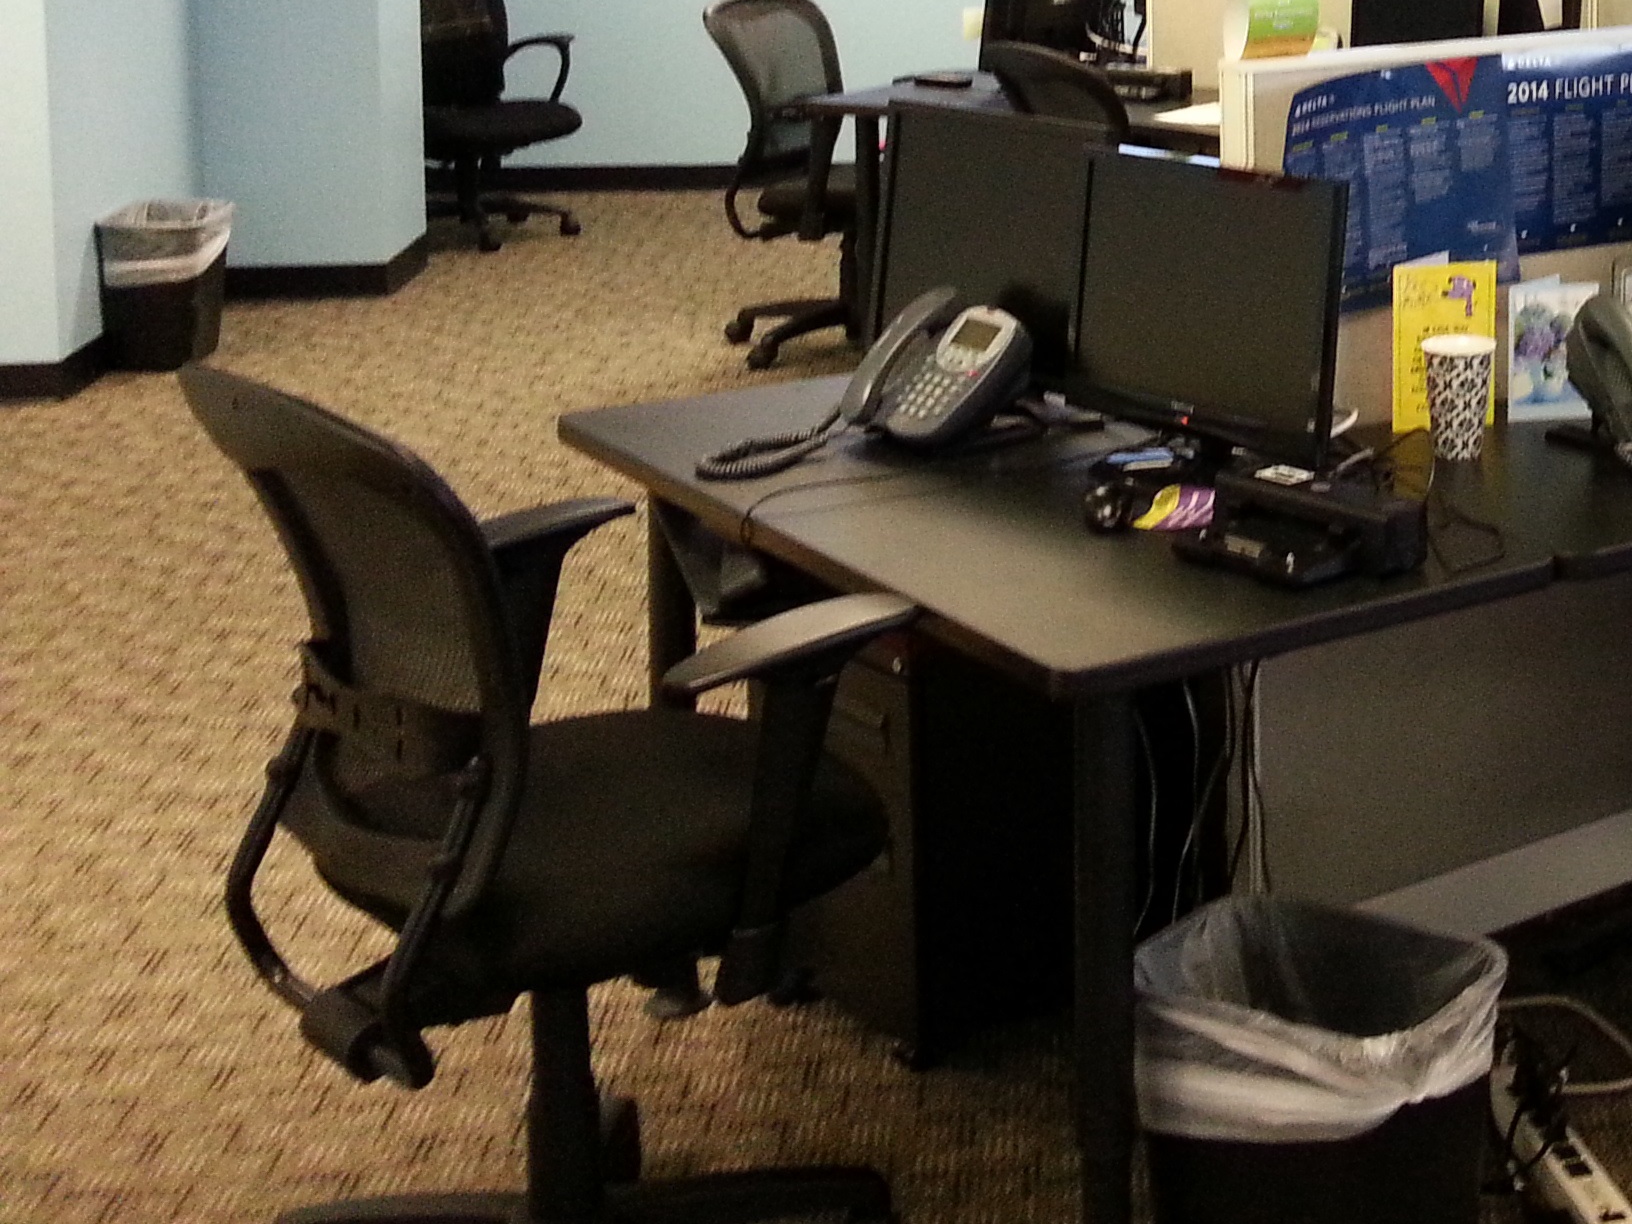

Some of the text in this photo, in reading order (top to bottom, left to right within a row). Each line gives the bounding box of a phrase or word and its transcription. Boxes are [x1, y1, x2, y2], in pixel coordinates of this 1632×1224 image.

[1517, 56, 1551, 68] DELTA
[1507, 79, 1549, 104] 2014
[1555, 73, 1615, 100] FLIGHT
[1410, 94, 1436, 110] PLAN
